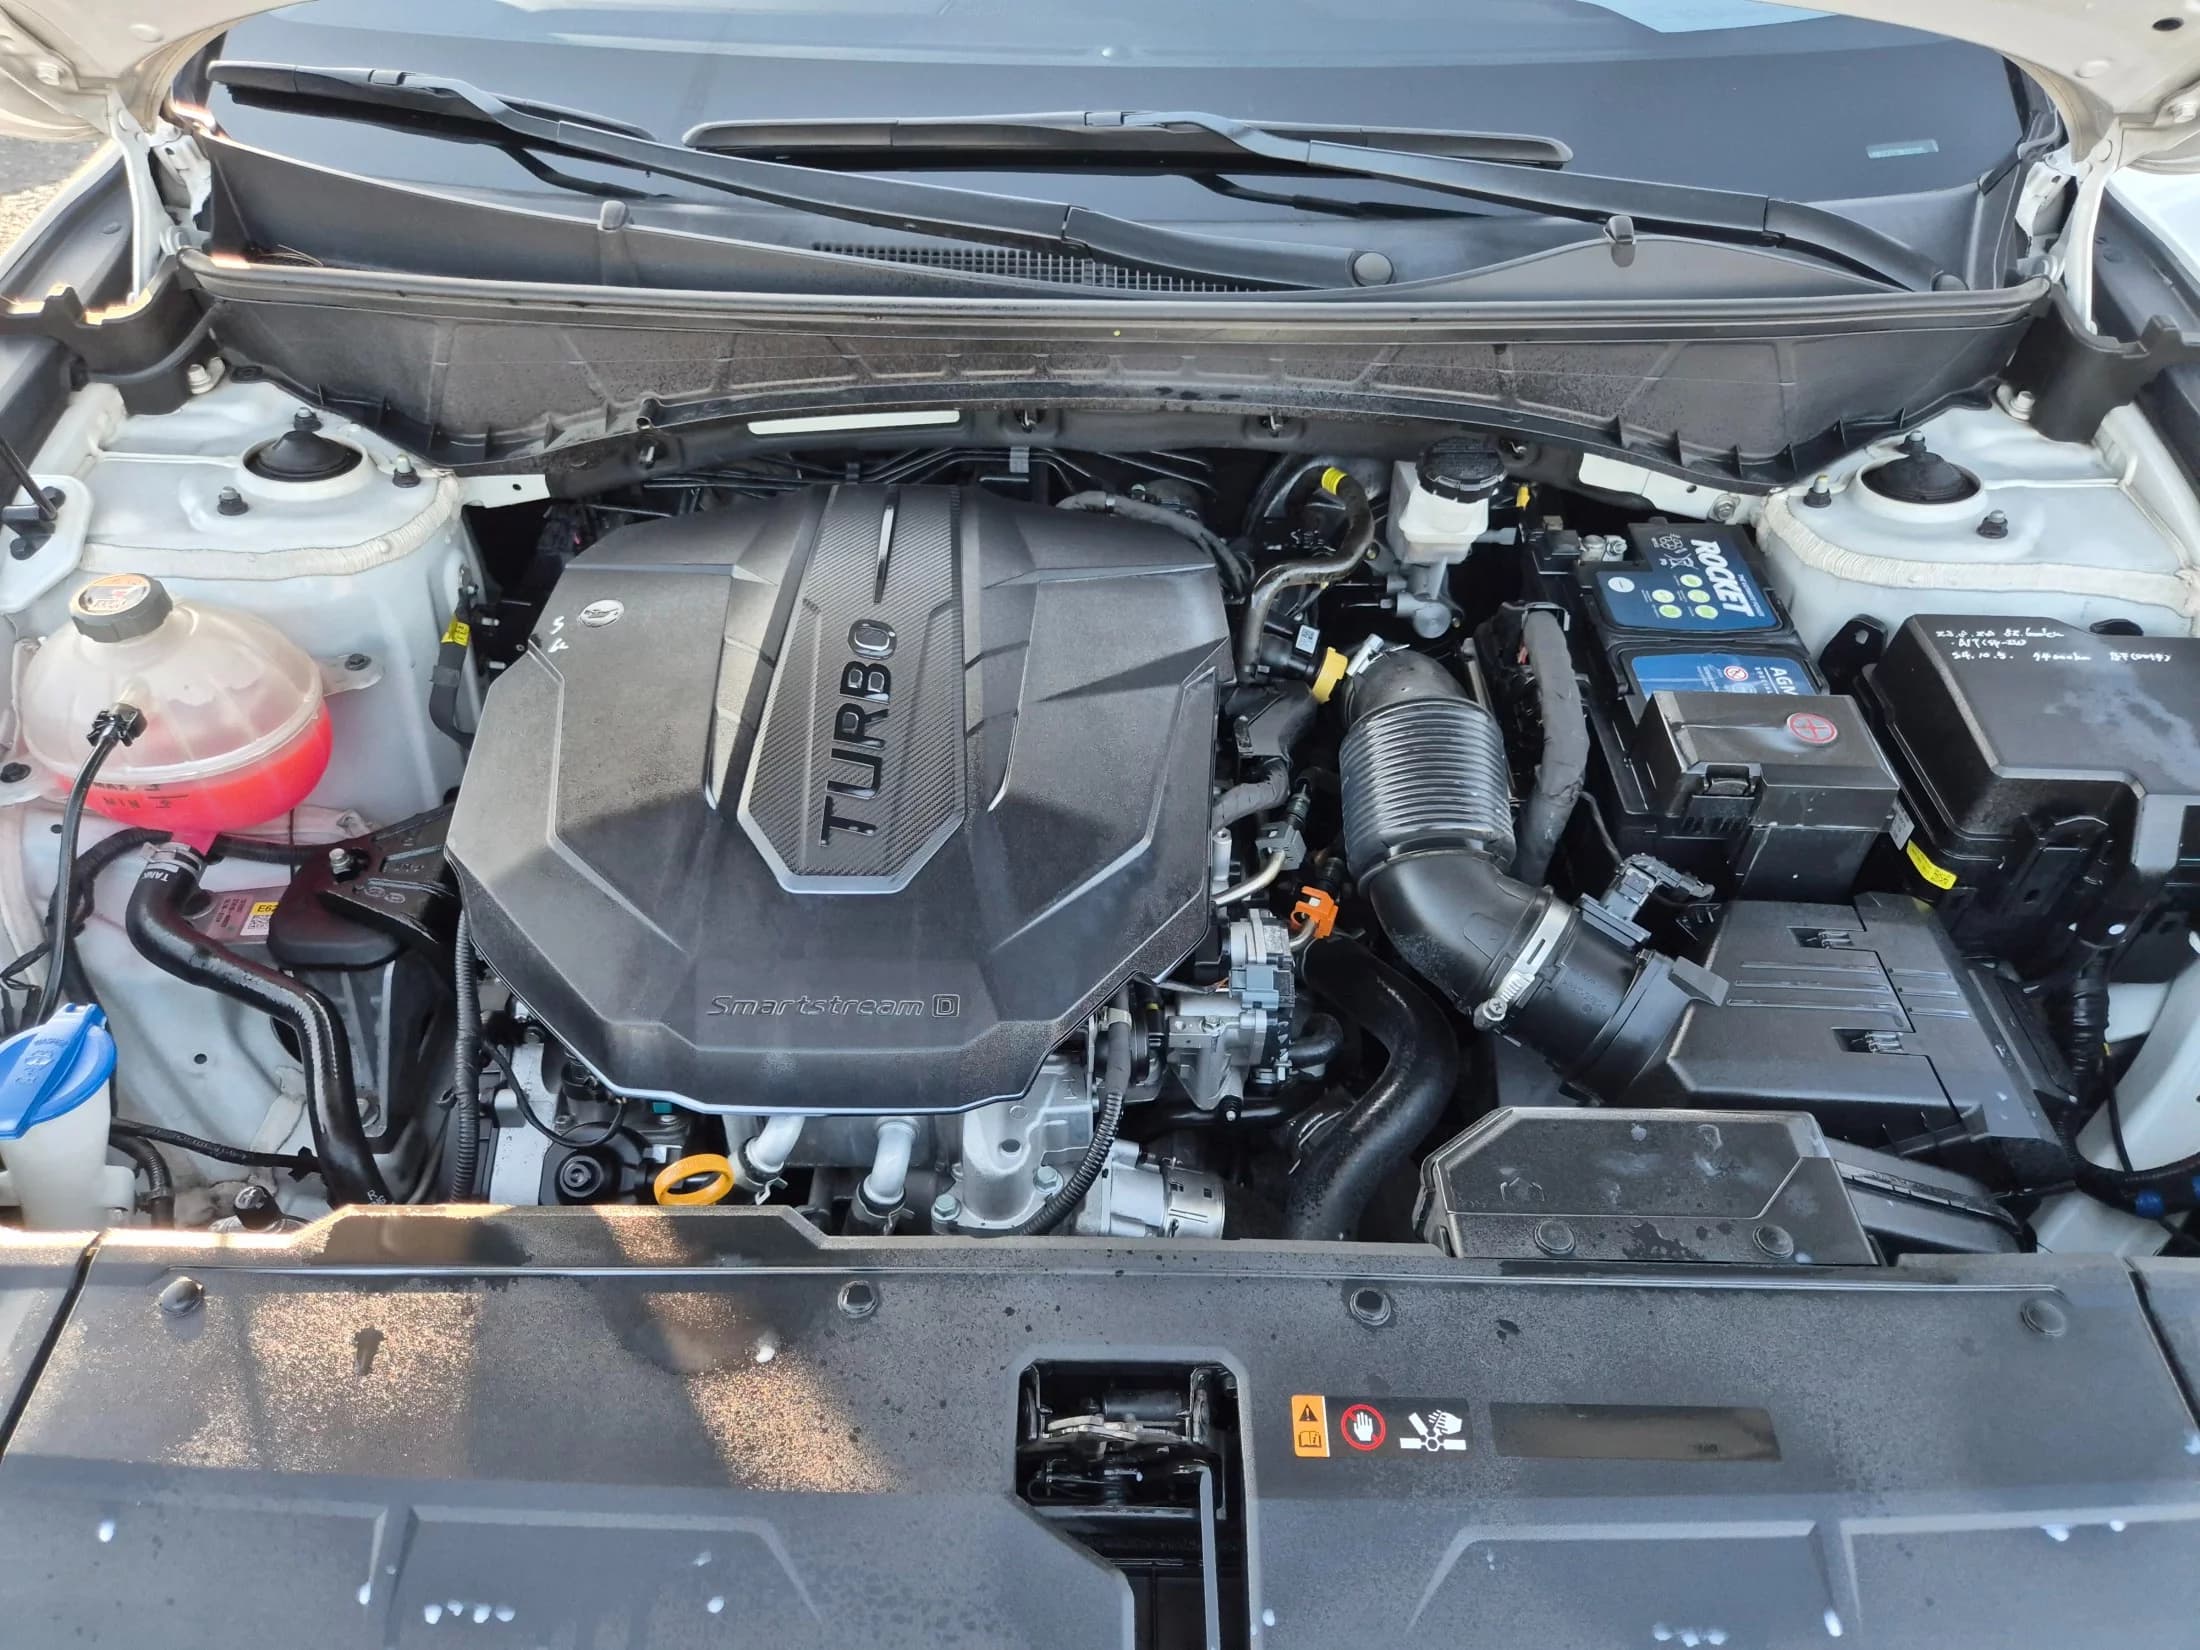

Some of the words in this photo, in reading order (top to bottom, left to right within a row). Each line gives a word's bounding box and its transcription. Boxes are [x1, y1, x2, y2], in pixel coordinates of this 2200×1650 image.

[1691, 538, 1756, 618] ROCKET
[819, 618, 897, 847] TURBO
[707, 994, 925, 1016] Smartstream
